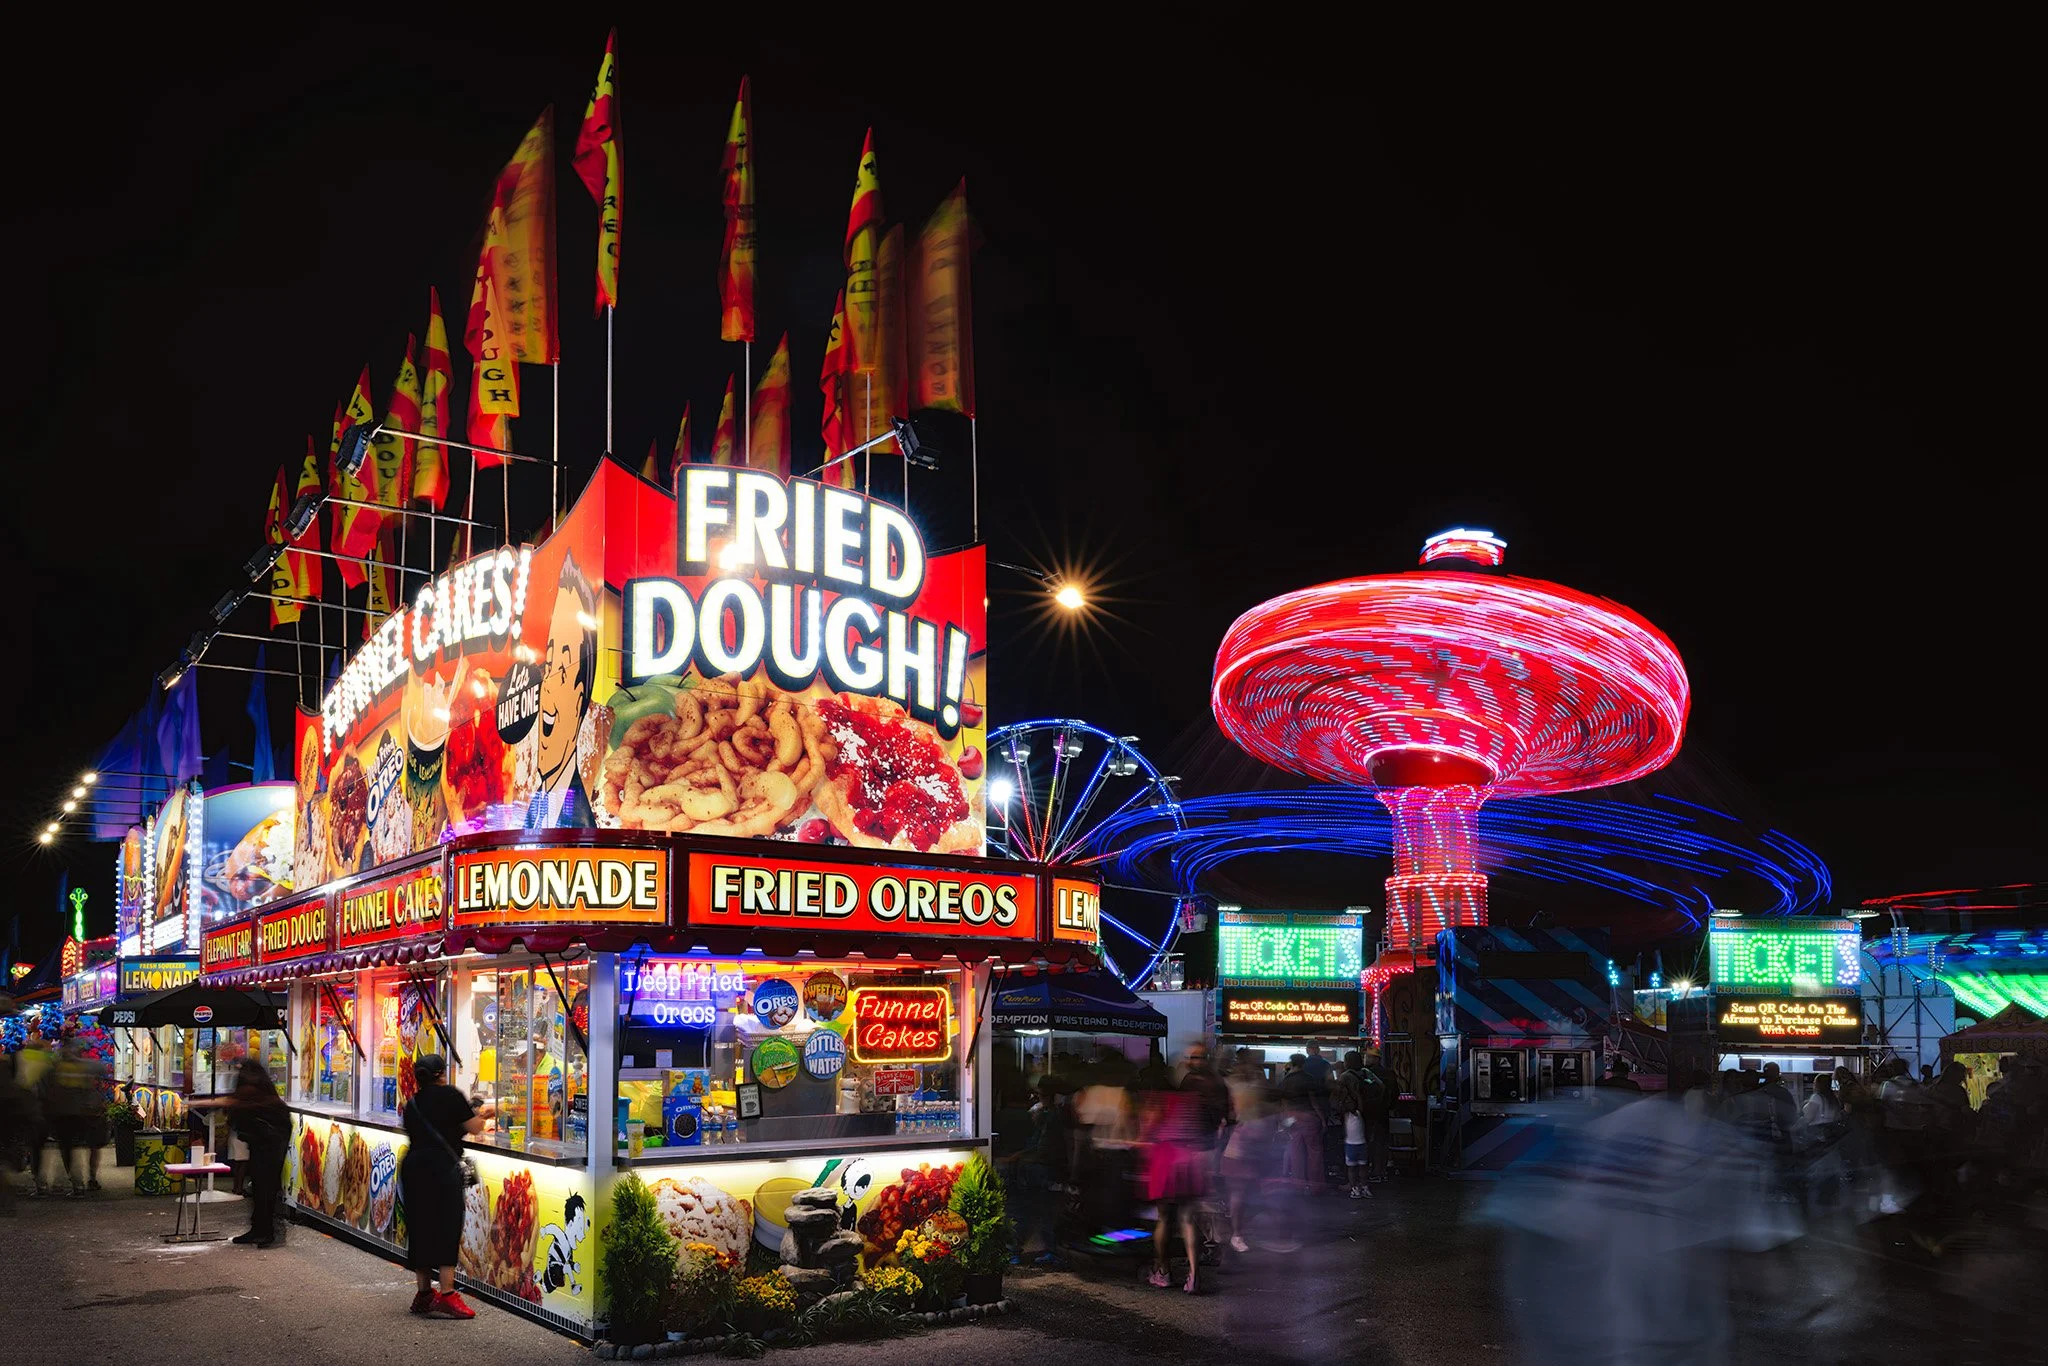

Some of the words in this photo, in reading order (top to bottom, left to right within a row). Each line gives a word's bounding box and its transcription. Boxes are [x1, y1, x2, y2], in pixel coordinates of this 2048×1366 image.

[685, 468, 924, 599] FRIED
[323, 610, 410, 755] FUNNEL
[411, 545, 533, 662] CAKES!
[631, 578, 969, 728] DOUGH!
[498, 694, 520, 731] HAVE
[520, 684, 540, 719] ONE
[366, 747, 404, 824] OREO
[456, 859, 659, 912] LEMONADE
[713, 866, 860, 918] FRIED
[868, 875, 1019, 926] OREOS
[342, 889, 391, 936] FUNNEL
[394, 873, 444, 925] CAKES
[263, 918, 289, 953] FRIED
[290, 908, 327, 947] DOUGH
[207, 931, 236, 963] ELEPHANT
[237, 928, 251, 958] EAR
[1220, 927, 1360, 978] TICKETS
[1711, 932, 1860, 985] TICKETS
[624, 971, 680, 995] Deep
[685, 971, 746, 992] Fried
[803, 984, 829, 1000] SWEET
[831, 984, 846, 1002] TEA
[1224, 978, 1239, 987] No
[1241, 978, 1286, 988] refunds
[1293, 979, 1308, 988] No
[1310, 980, 1355, 989] refunds
[1716, 985, 1733, 994] No
[1734, 986, 1782, 994] refunds
[113, 1011, 136, 1024] PEPSI
[653, 1002, 716, 1025] Oreos
[859, 995, 945, 1019] Funnel
[1230, 1001, 1249, 1010] Scan
[1250, 1001, 1264, 1012] QR
[1265, 1002, 1286, 1011] Code
[1286, 1002, 1299, 1011] On
[1300, 1002, 1316, 1012] The
[1317, 1002, 1346, 1012] Aframe
[1230, 1012, 1239, 1020] to
[1240, 1012, 1276, 1021] Purchase
[1276, 1013, 1303, 1022] Online
[1304, 1013, 1325, 1022] With
[1325, 1014, 1350, 1023] Credit
[1731, 1003, 1756, 1013] Scan
[1758, 1003, 1778, 1015] QR
[1779, 1004, 1806, 1014] Code
[1808, 1004, 1824, 1014] On
[1826, 1004, 1847, 1015] The
[1055, 1015, 1109, 1026] WRISTBAND
[1111, 1018, 1167, 1031] REDEMPTION
[1721, 1014, 1760, 1024] Aframe
[1762, 1015, 1773, 1025] to
[1774, 1015, 1821, 1025] Purchase
[1823, 1016, 1857, 1026] Online
[1760, 1025, 1785, 1035] With
[1787, 1025, 1820, 1036] Credit
[805, 1034, 845, 1056] BOTTLED
[865, 1023, 939, 1049] Cakes
[808, 1056, 842, 1075] WATER
[370, 1152, 396, 1192] OREO
